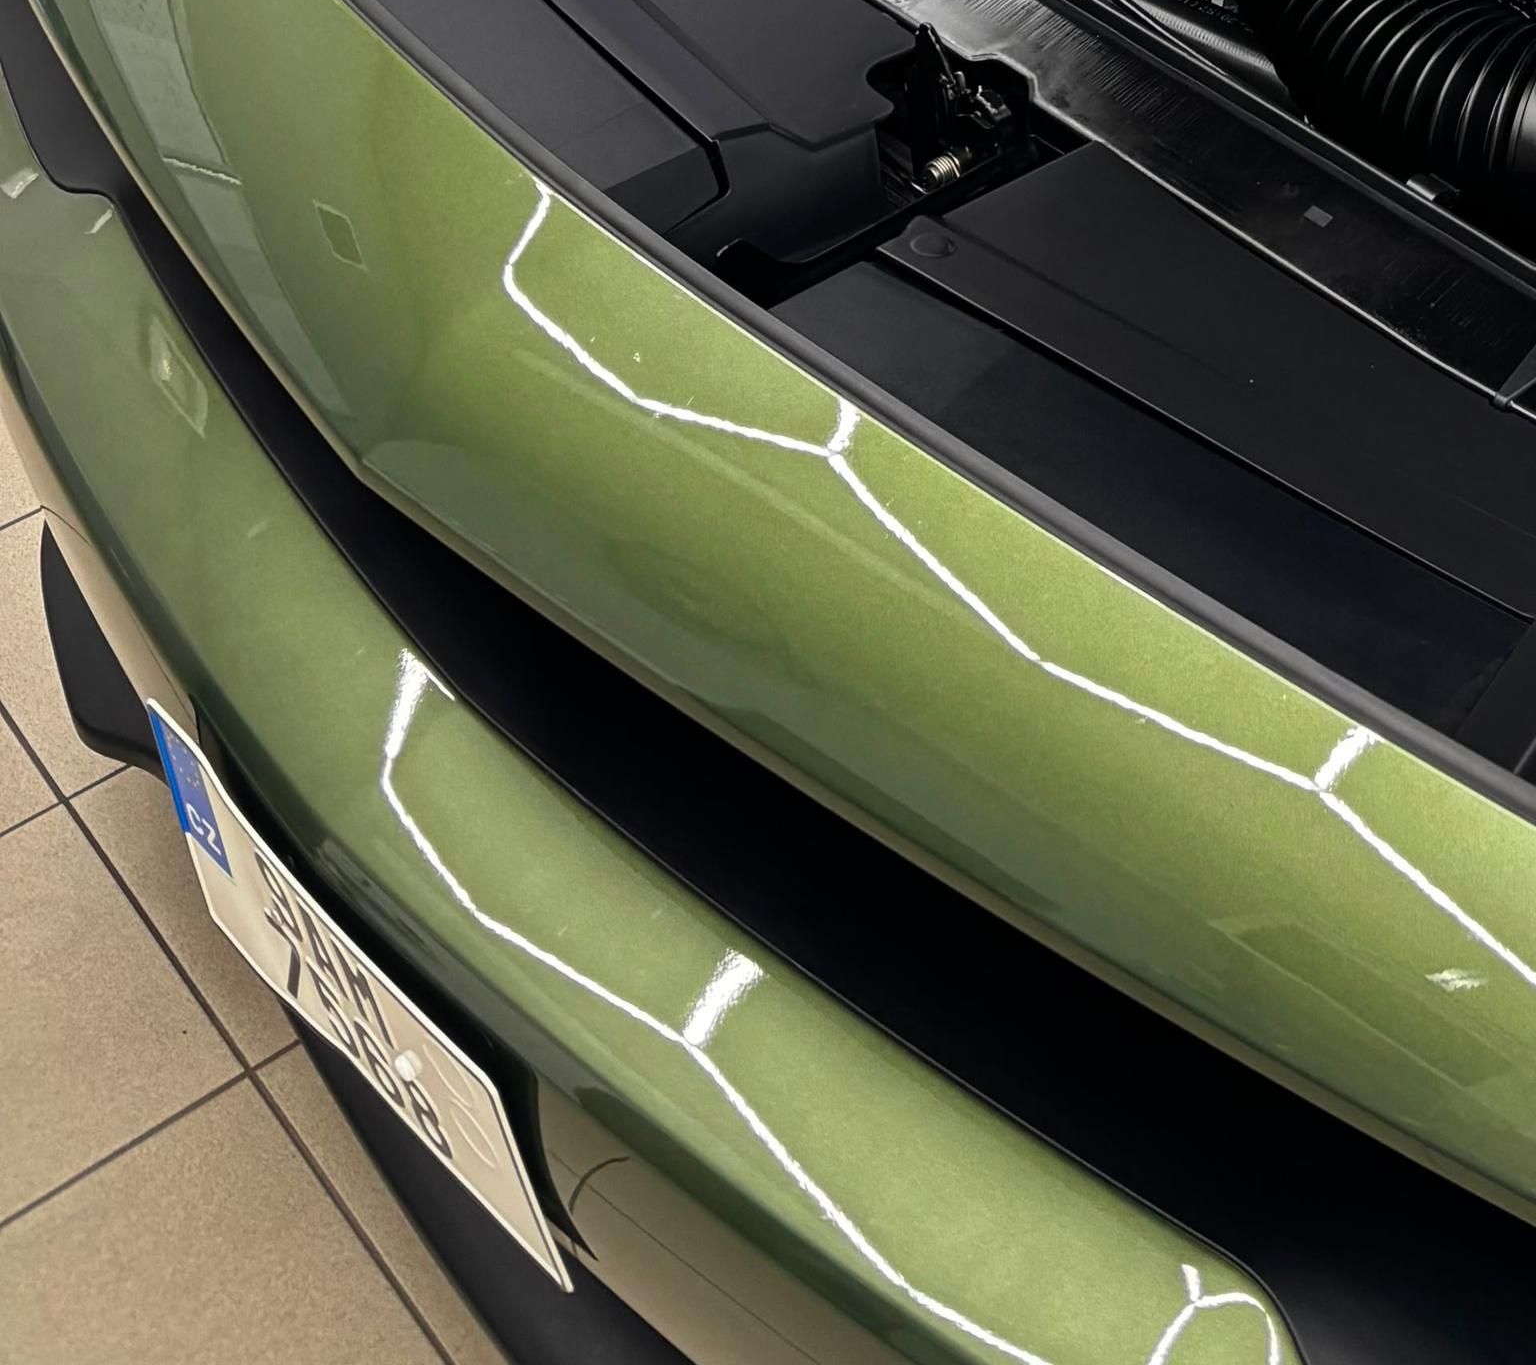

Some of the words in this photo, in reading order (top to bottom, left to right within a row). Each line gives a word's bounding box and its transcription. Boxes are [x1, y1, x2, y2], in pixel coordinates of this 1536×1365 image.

[186, 801, 223, 857] CZ
[254, 846, 397, 1051] 9AM
[264, 906, 453, 1160] 7568
